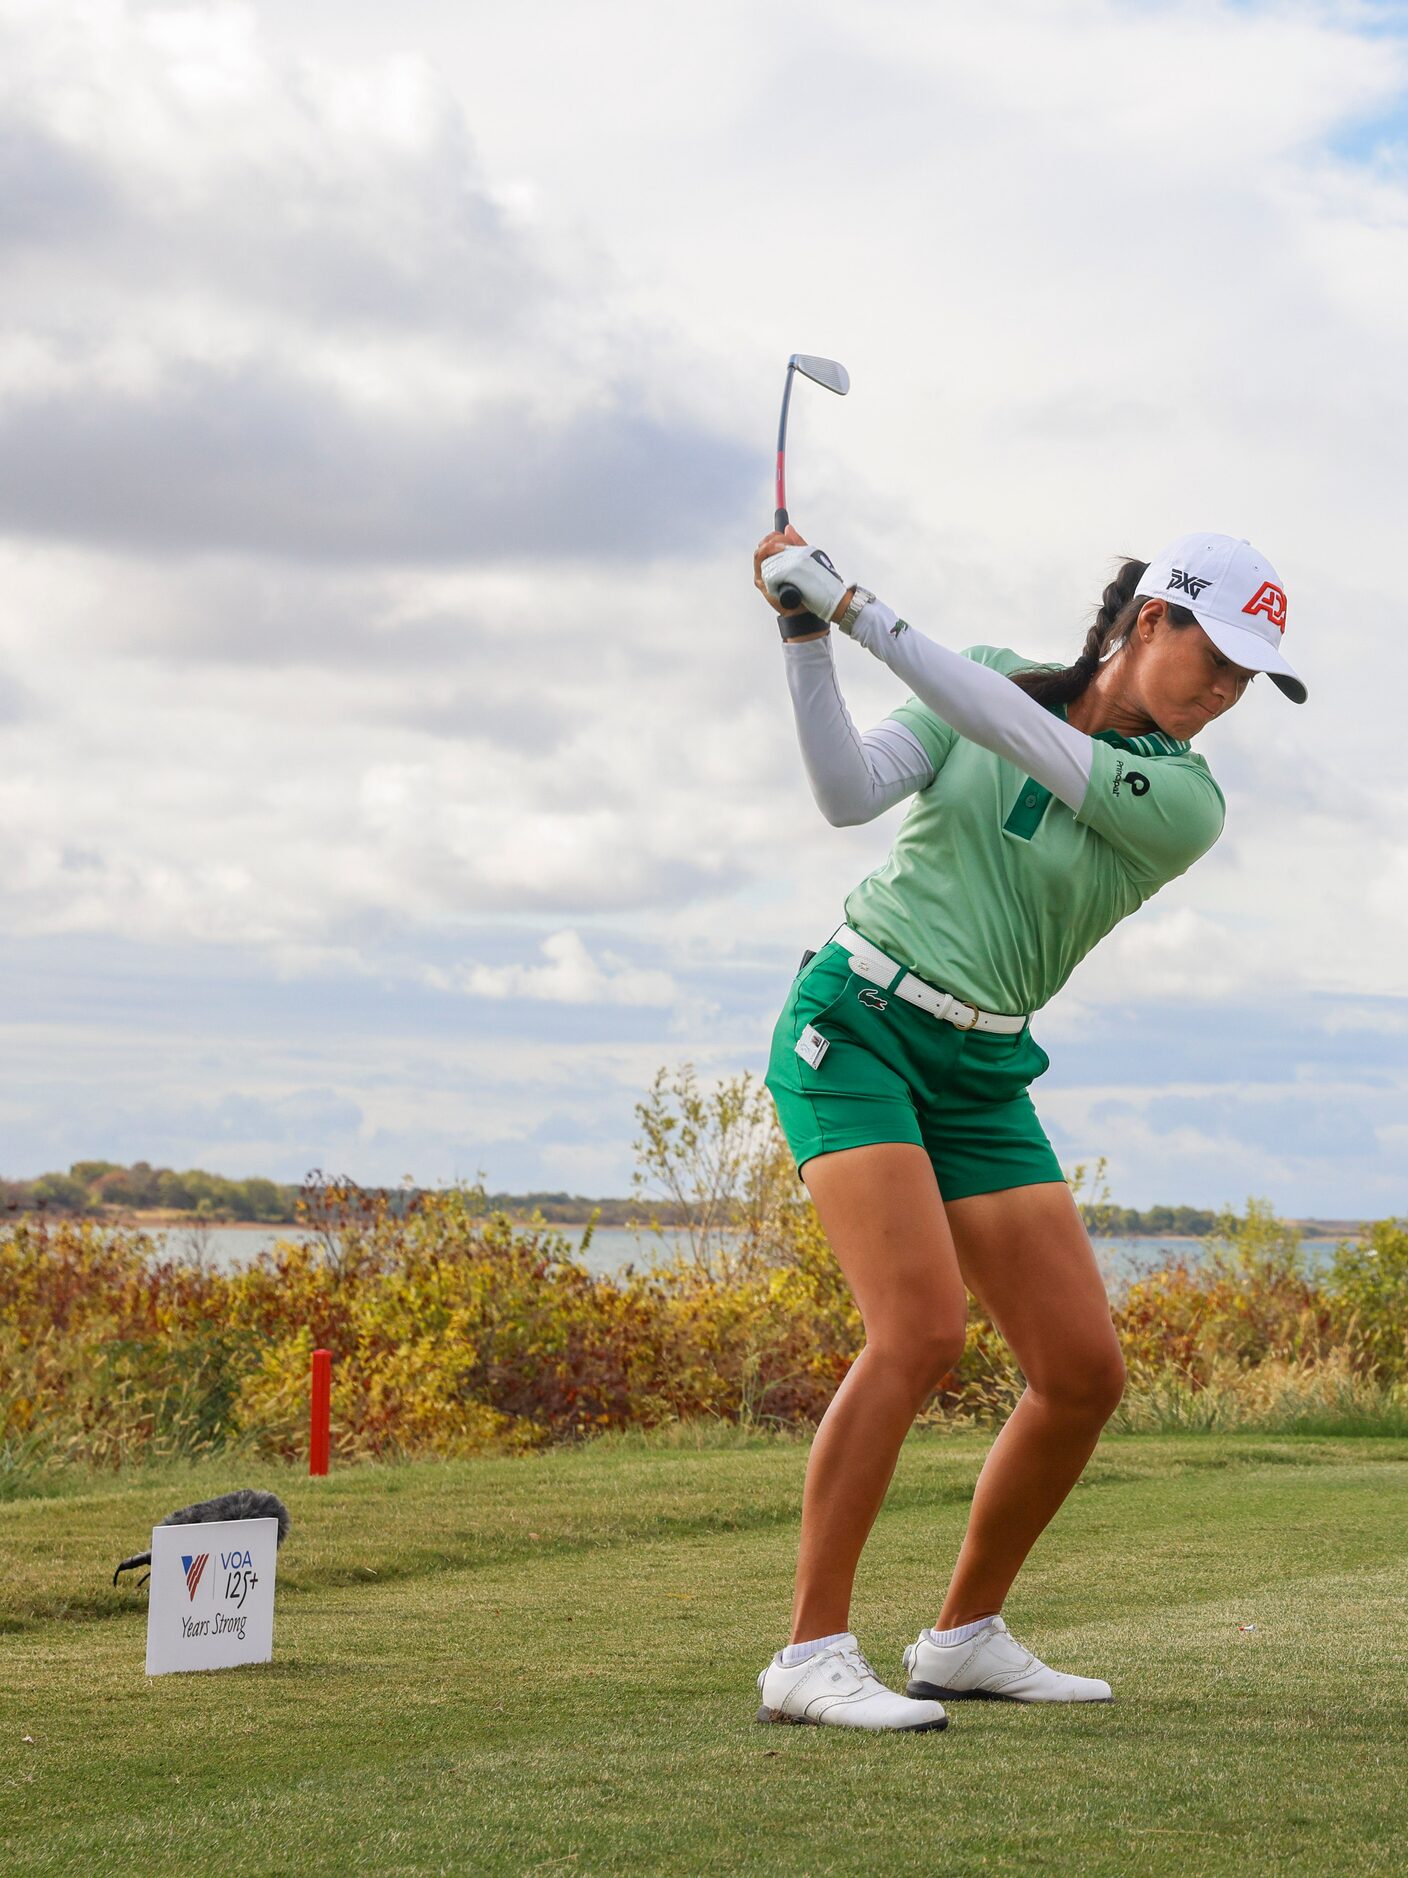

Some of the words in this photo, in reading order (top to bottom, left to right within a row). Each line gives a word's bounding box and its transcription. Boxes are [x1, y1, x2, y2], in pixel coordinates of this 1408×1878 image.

[1166, 568, 1213, 601] PXG
[220, 1550, 253, 1570] VOA
[224, 1570, 259, 1609] 125+
[181, 1615, 210, 1638] Years
[211, 1612, 248, 1640] Strong
